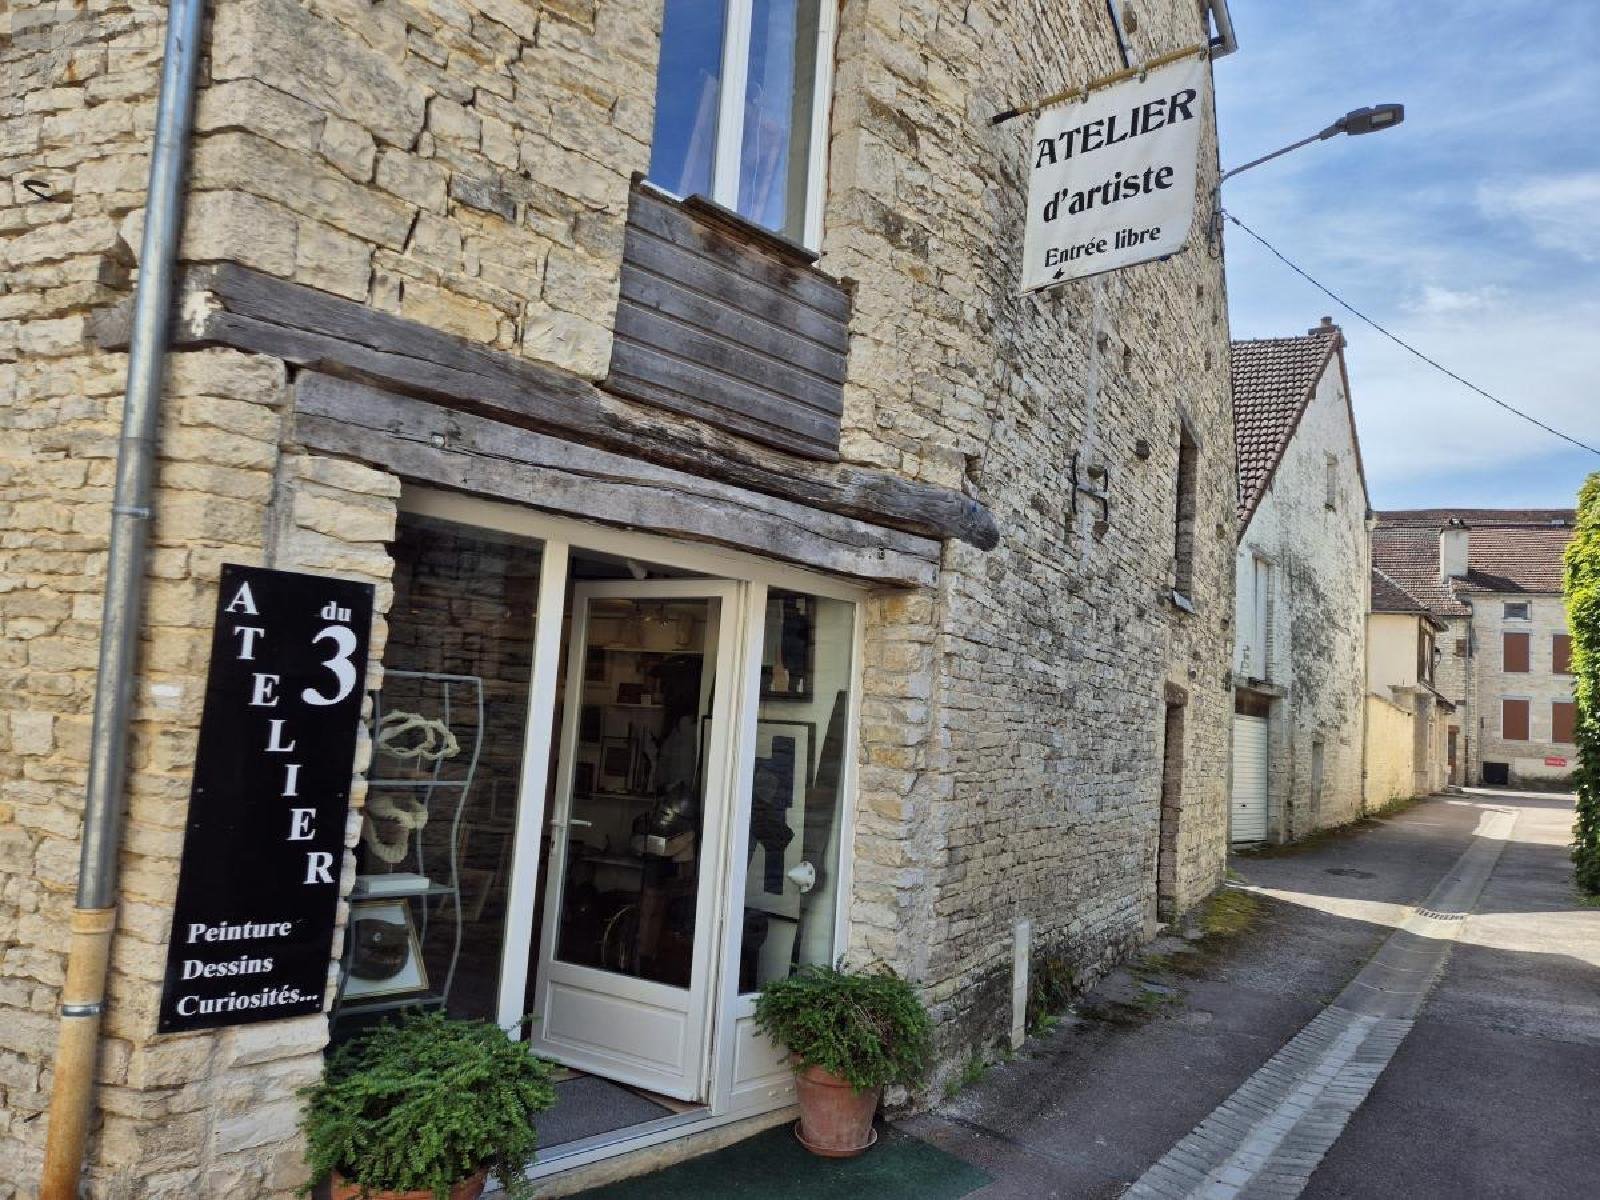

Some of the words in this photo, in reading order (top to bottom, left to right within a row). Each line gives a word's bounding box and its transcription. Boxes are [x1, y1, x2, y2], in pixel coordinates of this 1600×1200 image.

[1035, 88, 1196, 168] ATELIER
[1043, 166, 1174, 223] d'artiste
[1044, 237, 1108, 267] Entrée
[1114, 226, 1161, 250] libre
[320, 601, 352, 622] du
[301, 624, 357, 706] 3
[224, 580, 335, 885] ATELIER
[186, 920, 292, 943] Peinture
[181, 954, 274, 980] Dessins
[176, 984, 319, 1016] Curiosités...
